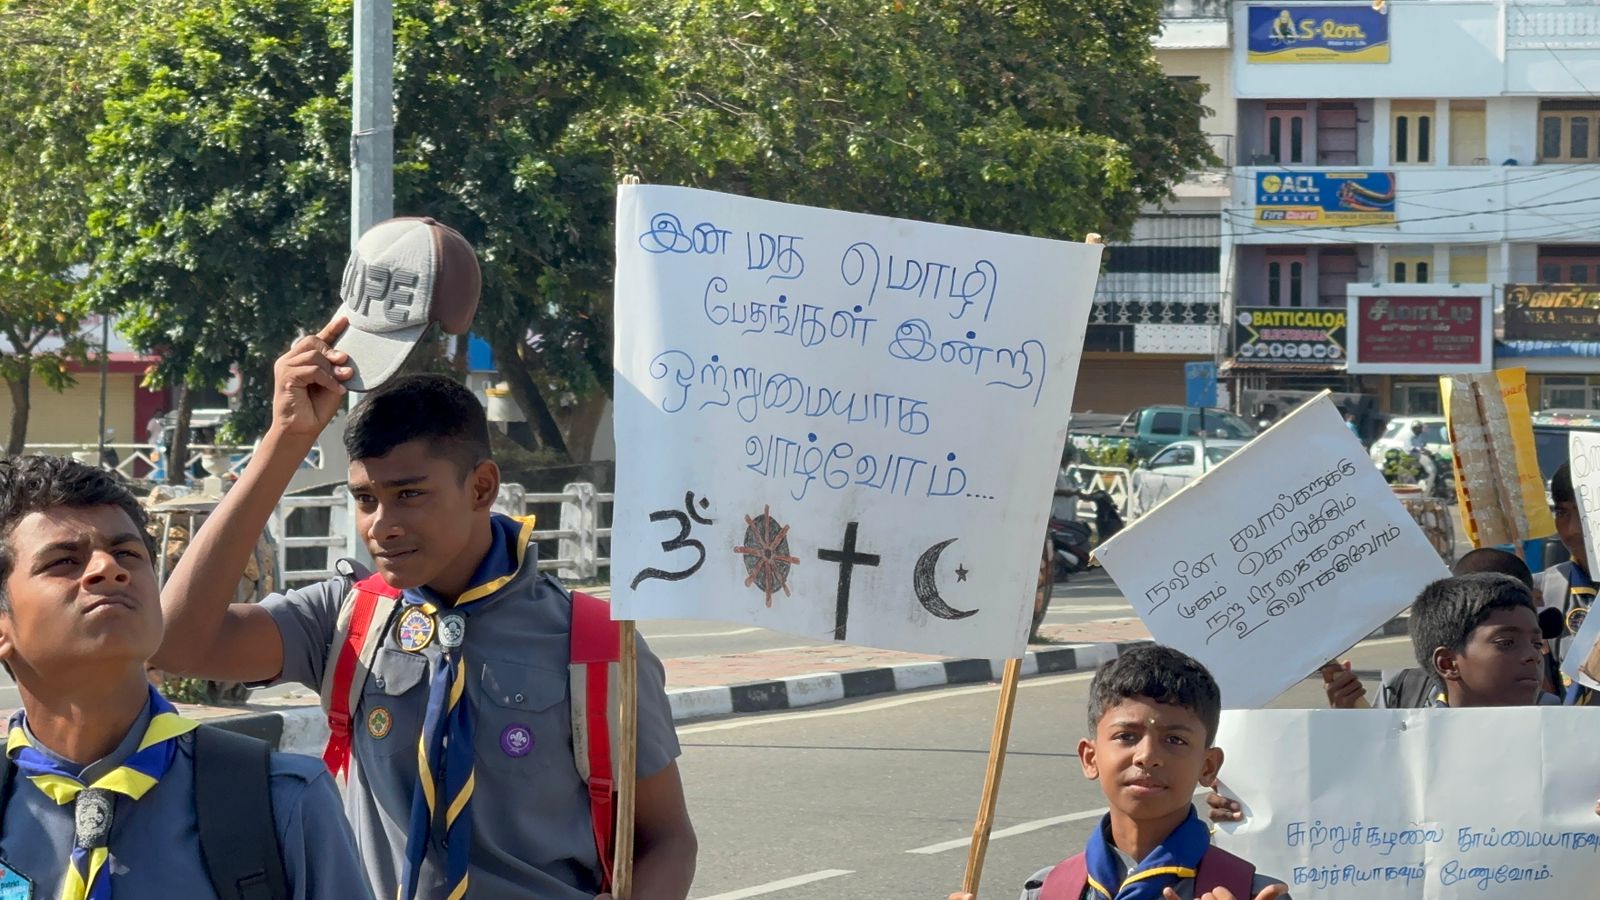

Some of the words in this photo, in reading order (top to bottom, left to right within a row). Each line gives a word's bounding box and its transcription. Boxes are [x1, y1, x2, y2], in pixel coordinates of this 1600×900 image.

[1281, 176, 1320, 193] ACL
[1263, 210, 1285, 220] Fire
[638, 212, 732, 255] இன
[747, 231, 804, 284] மத
[840, 241, 998, 321] மொழி
[1253, 311, 1345, 327] BATTICALOA
[703, 276, 878, 348] பேதங்கள்
[888, 318, 1046, 407] இன்றி
[649, 349, 930, 435] ஒற்றுமையாக
[1144, 552, 1219, 615] நவீன
[1177, 581, 1228, 619] முகம்
[1457, 826, 1600, 852] தூய்மையாகவு
[1293, 861, 1426, 890] கவர்ச்சியாகவும்
